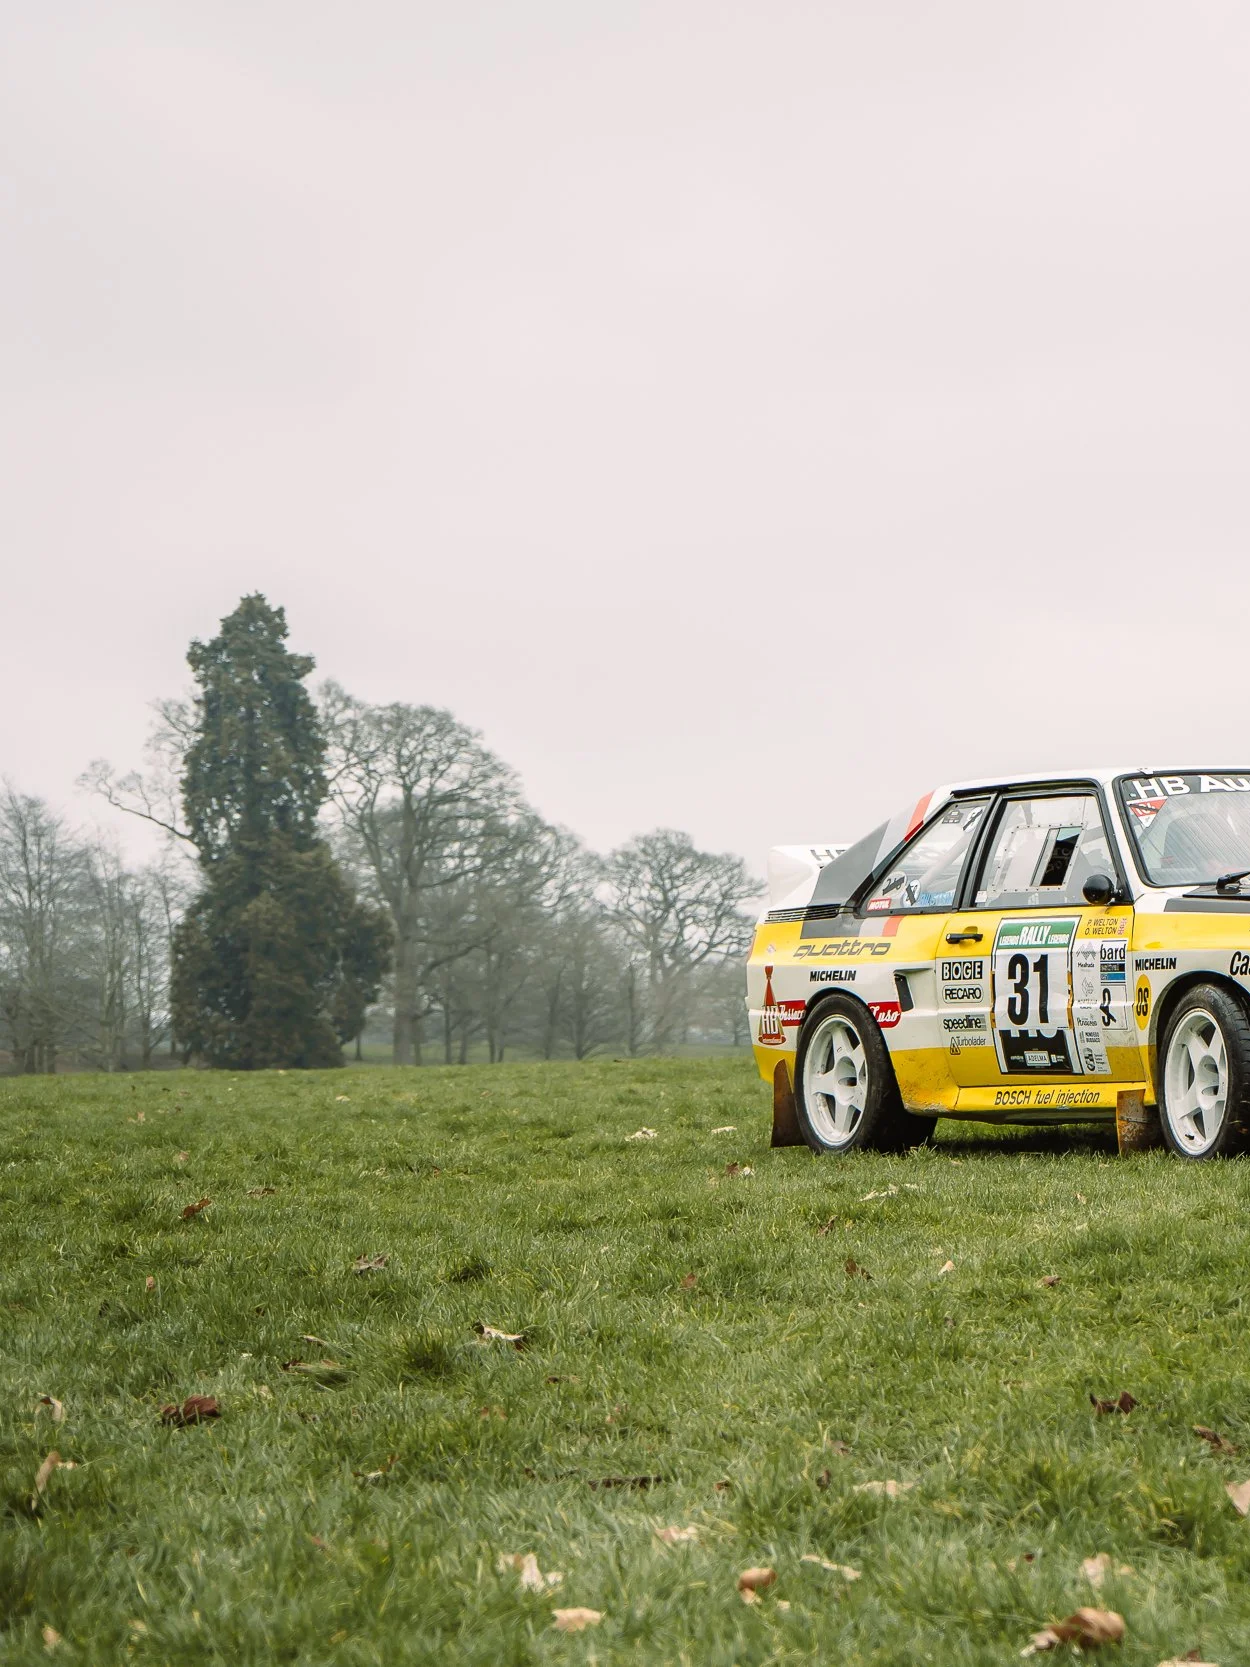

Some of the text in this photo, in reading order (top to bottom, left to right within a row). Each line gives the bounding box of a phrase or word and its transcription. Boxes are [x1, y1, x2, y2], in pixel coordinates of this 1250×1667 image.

[1132, 777, 1191, 799] HB
[810, 849, 847, 861] H
[1092, 926, 1117, 935] WELTON
[1093, 918, 1118, 927] WELTON
[1019, 925, 1052, 945] RALLY
[793, 939, 891, 959] quattro
[942, 961, 983, 980] BOGE
[1135, 957, 1177, 971] MICHELIN
[809, 970, 857, 982] MICHELIN
[944, 987, 982, 1000] RECARO
[1008, 953, 1049, 1026] 31
[762, 1005, 779, 1035] HB
[870, 1005, 900, 1023] Luso
[955, 1036, 986, 1046] Turbolader
[994, 1089, 1100, 1106] BOSCH fuel injection
